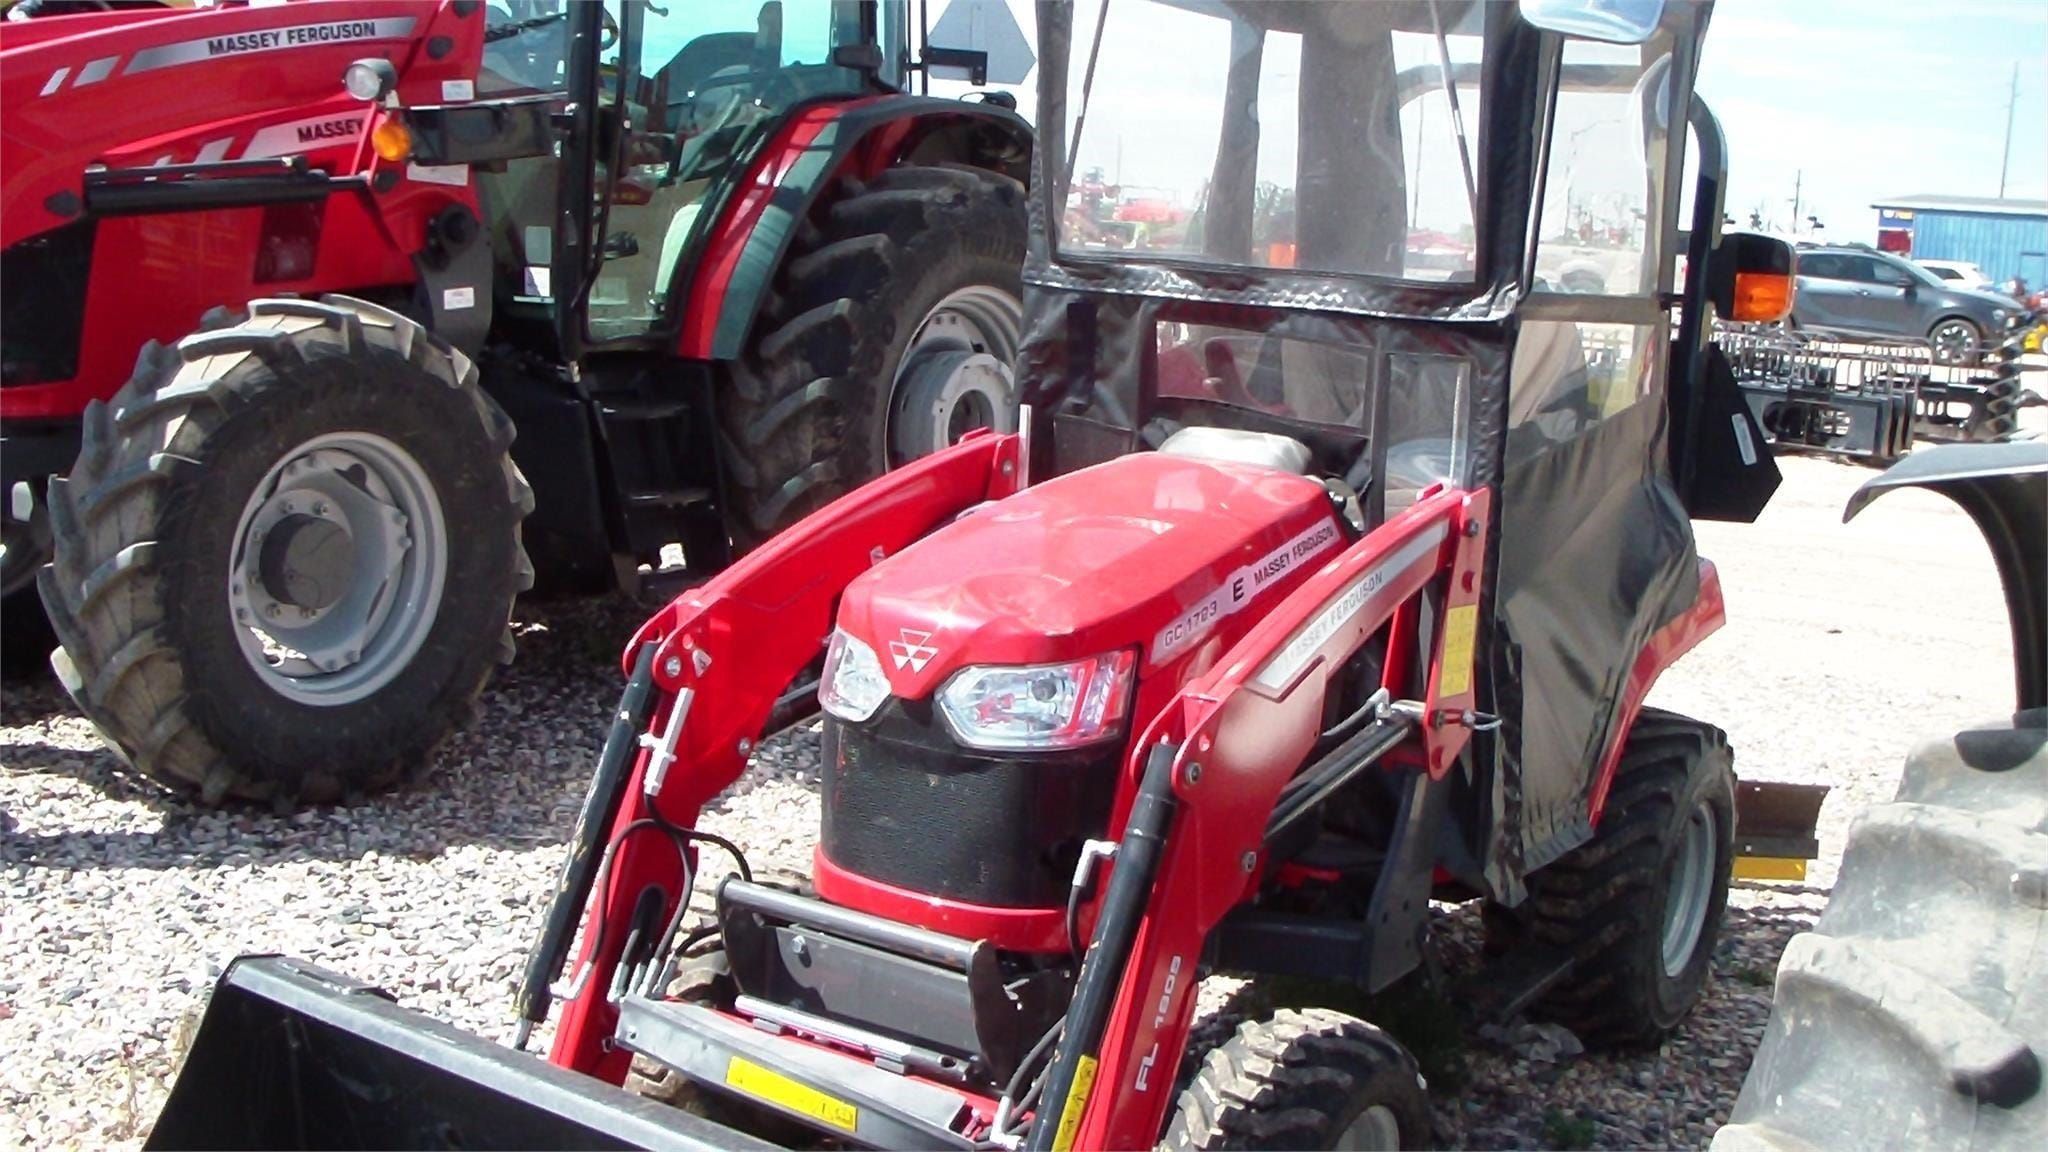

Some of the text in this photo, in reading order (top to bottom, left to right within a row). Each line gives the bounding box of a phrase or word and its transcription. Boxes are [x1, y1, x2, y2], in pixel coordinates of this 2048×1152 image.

[208, 22, 376, 55] MASSEY FERGUSON
[1165, 623, 1183, 647] GC
[1232, 577, 1245, 603] E
[1253, 552, 1291, 586] MASSEY
[1329, 570, 1384, 626] FERGUSON
[1134, 1042, 1159, 1091] FL
